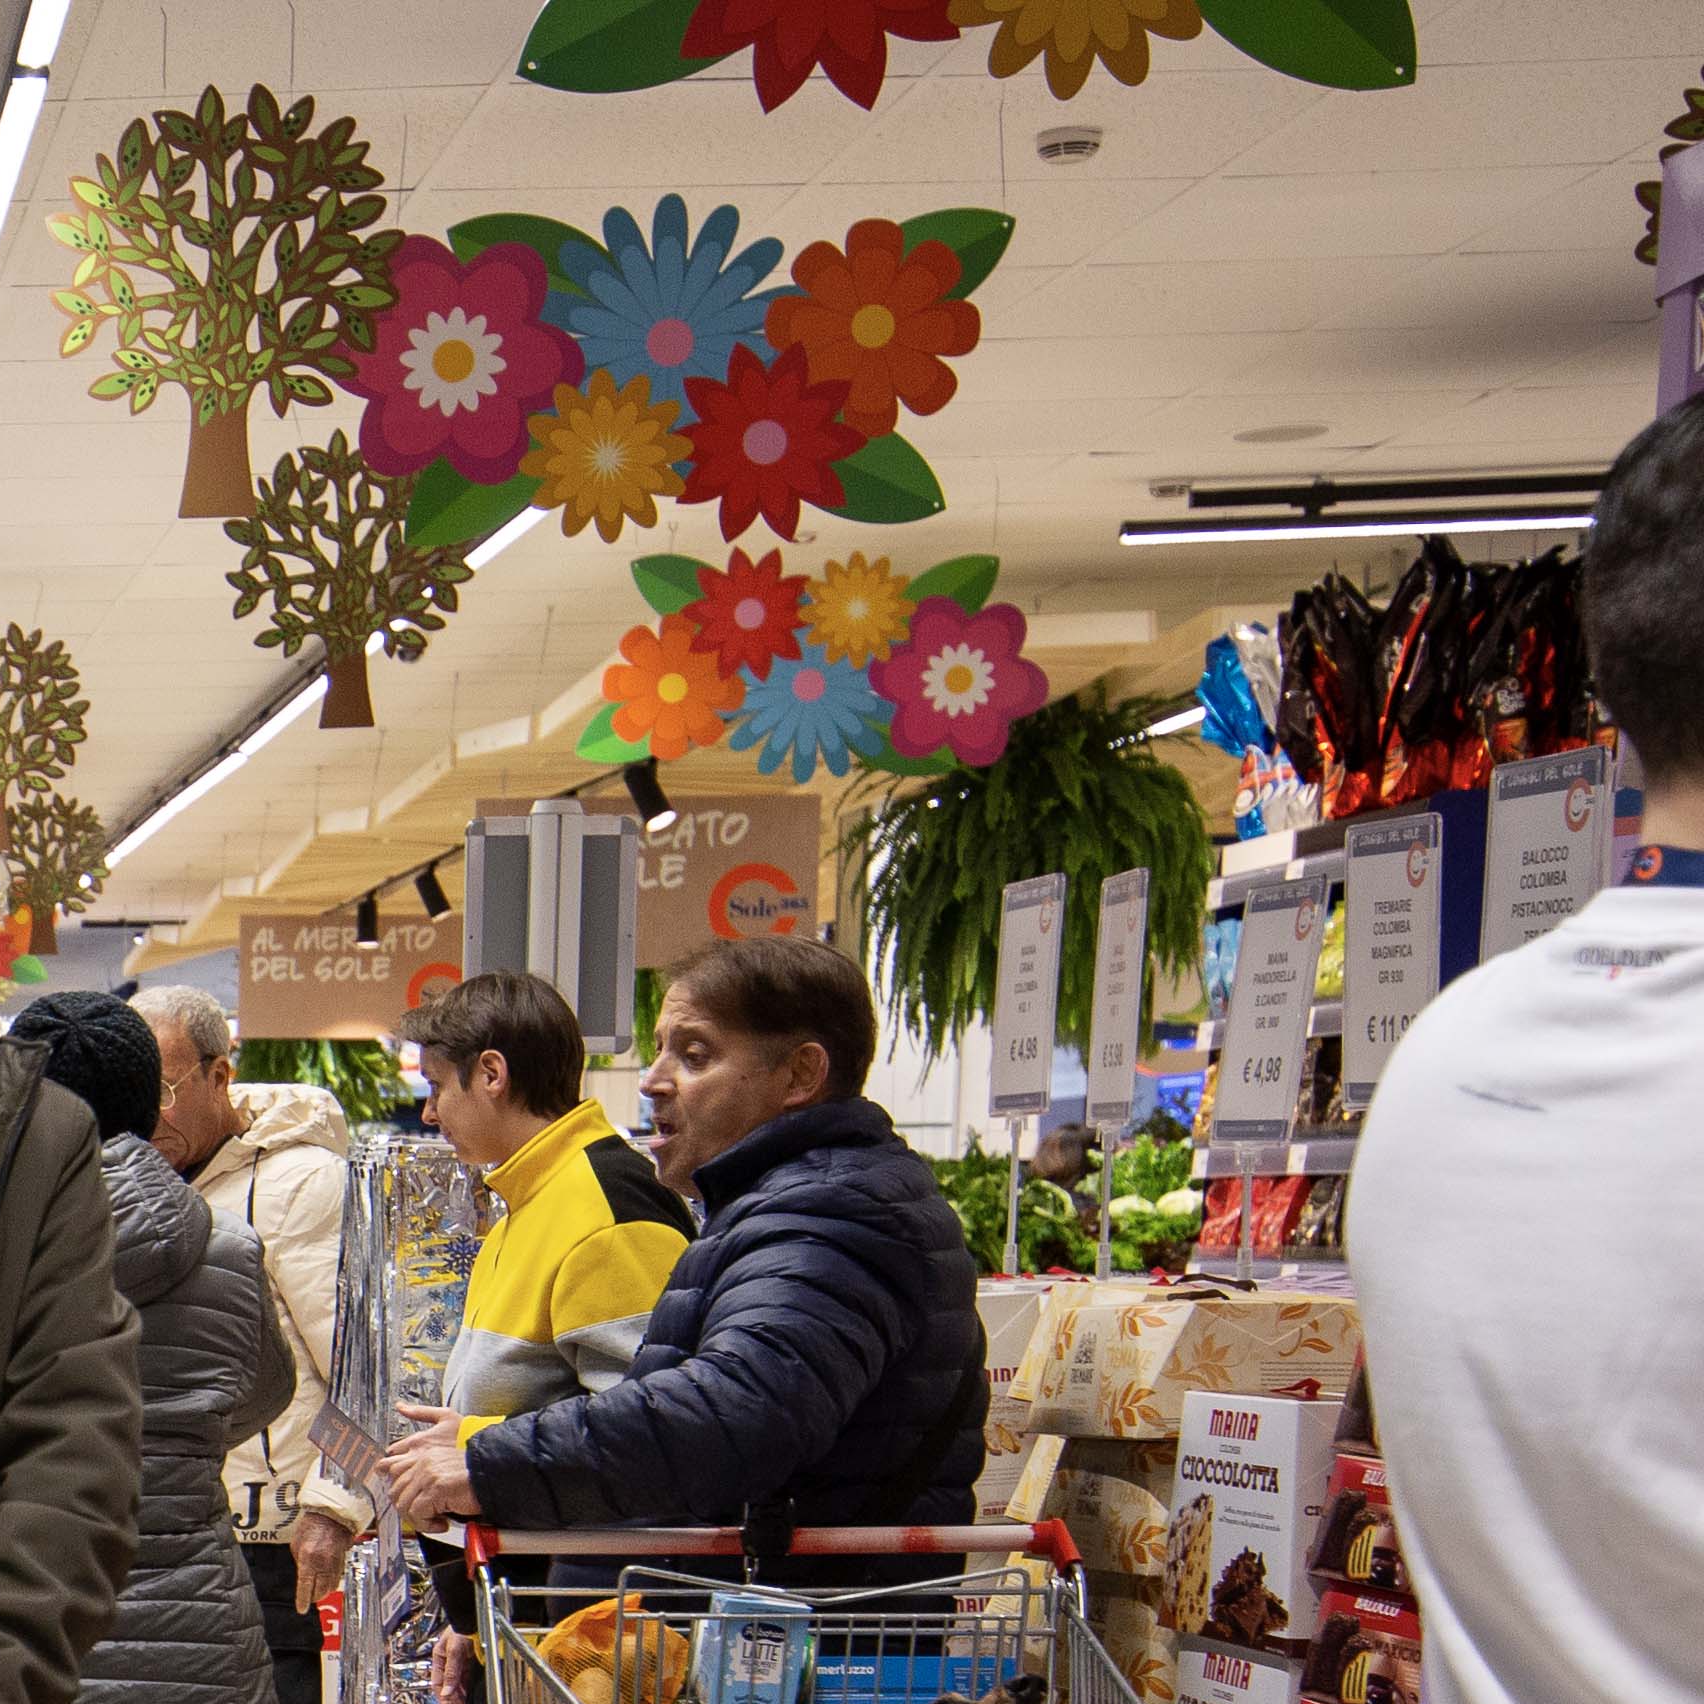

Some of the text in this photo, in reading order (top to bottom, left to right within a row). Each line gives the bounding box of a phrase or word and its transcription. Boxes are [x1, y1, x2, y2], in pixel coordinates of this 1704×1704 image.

[1521, 846, 1569, 866] BALOCCO
[1519, 869, 1568, 890] COLOMBA
[1374, 898, 1412, 915] TREMARIE
[251, 924, 437, 952] AL MERATO
[1373, 920, 1411, 937] COLOMBA
[1371, 944, 1413, 961] MAGNIFICA
[250, 955, 392, 983] DEL SOLE
[1252, 970, 1297, 986] PANDORELLA
[1018, 1036, 1039, 1063] 4,98
[1243, 1056, 1282, 1088] € 4,98
[1209, 1408, 1260, 1442] MAINA
[1181, 1455, 1280, 1494] CIOCCOLOTTA
[232, 1482, 269, 1530] J
[241, 1530, 279, 1541] YORK
[1203, 1651, 1252, 1690] MAINA
